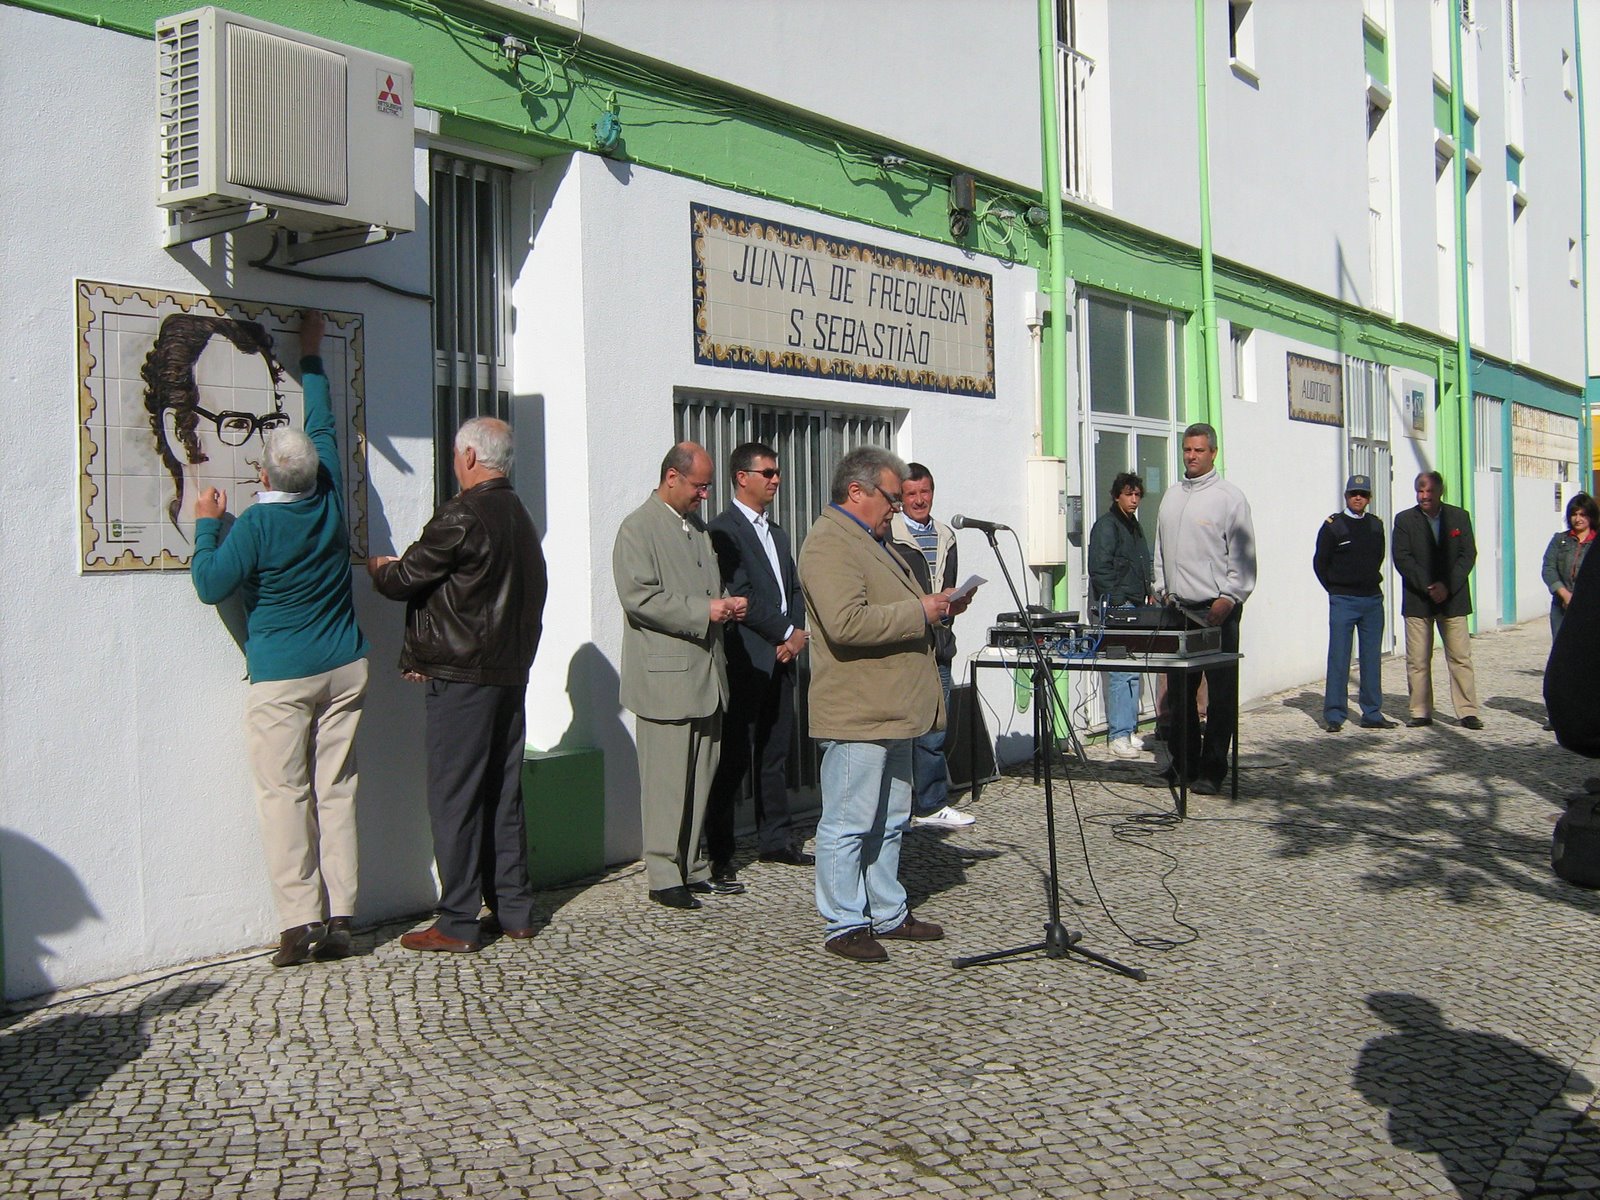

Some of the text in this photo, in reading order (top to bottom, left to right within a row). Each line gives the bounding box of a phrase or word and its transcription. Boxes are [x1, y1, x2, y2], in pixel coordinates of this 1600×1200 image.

[733, 245, 968, 325] JUNTA DE FREGUESIA
